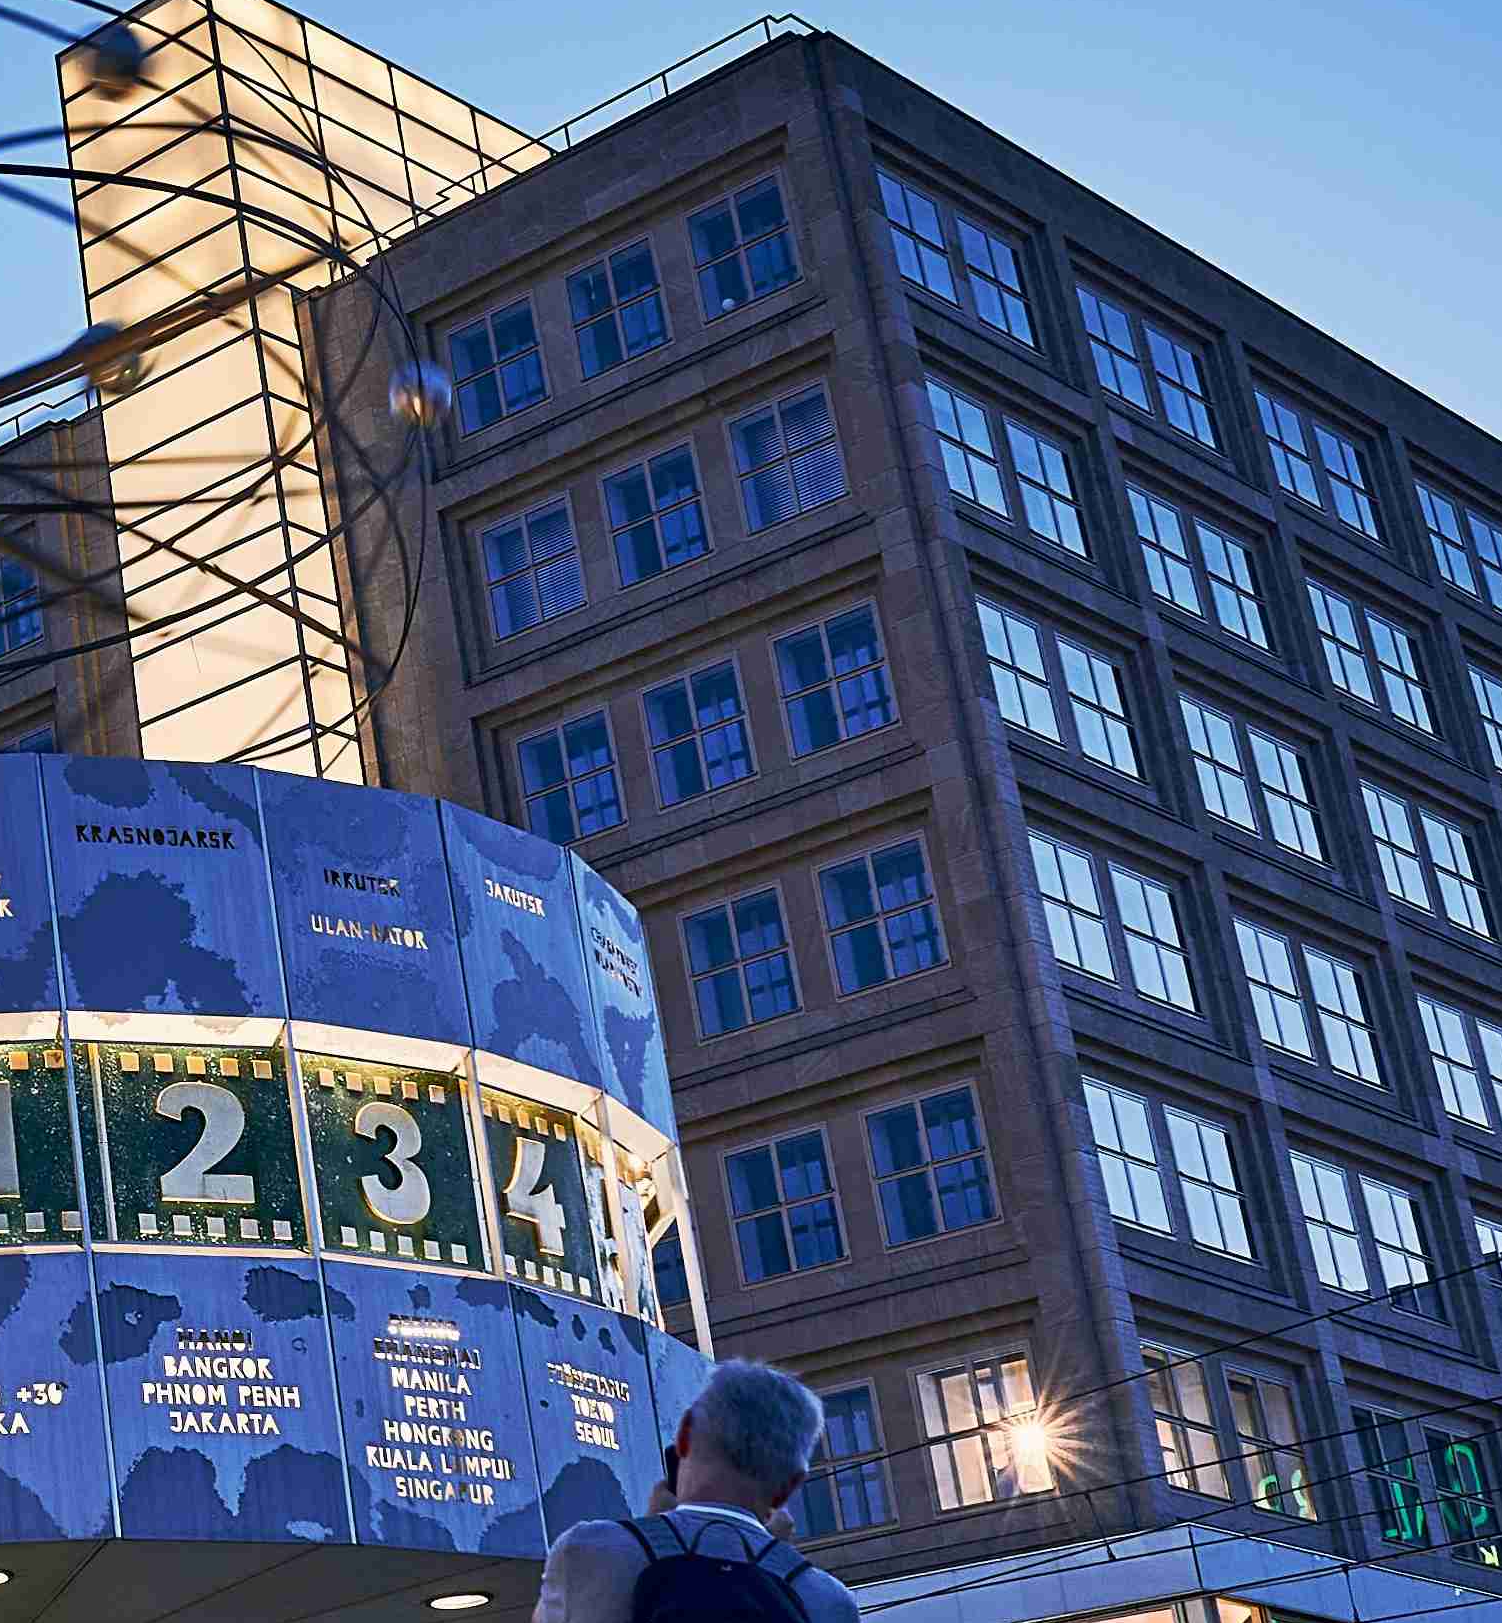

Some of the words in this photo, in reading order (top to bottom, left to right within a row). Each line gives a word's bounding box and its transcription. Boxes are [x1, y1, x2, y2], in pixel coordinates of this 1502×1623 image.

[75, 824, 236, 850] KRASNOJARSK
[323, 869, 401, 897] IRKUTSK
[484, 878, 545, 919] JAKUTSK
[155, 1081, 257, 1205] 2
[353, 1101, 433, 1225] 3
[502, 1135, 567, 1257] 4
[177, 1326, 253, 1352] HANOI
[163, 1355, 274, 1380] BANGKOK
[390, 1366, 473, 1396] MANILA
[142, 1383, 228, 1406] PHNOM
[238, 1384, 302, 1409] PENH
[404, 1395, 467, 1422] PERTH
[571, 1393, 616, 1424] TOKYO
[169, 1412, 281, 1436] JAKARTA
[383, 1419, 495, 1452] HONGKONG
[574, 1420, 620, 1450] SEOUL
[366, 1445, 433, 1473] KUALA
[395, 1476, 496, 1506] SINGAPUR
